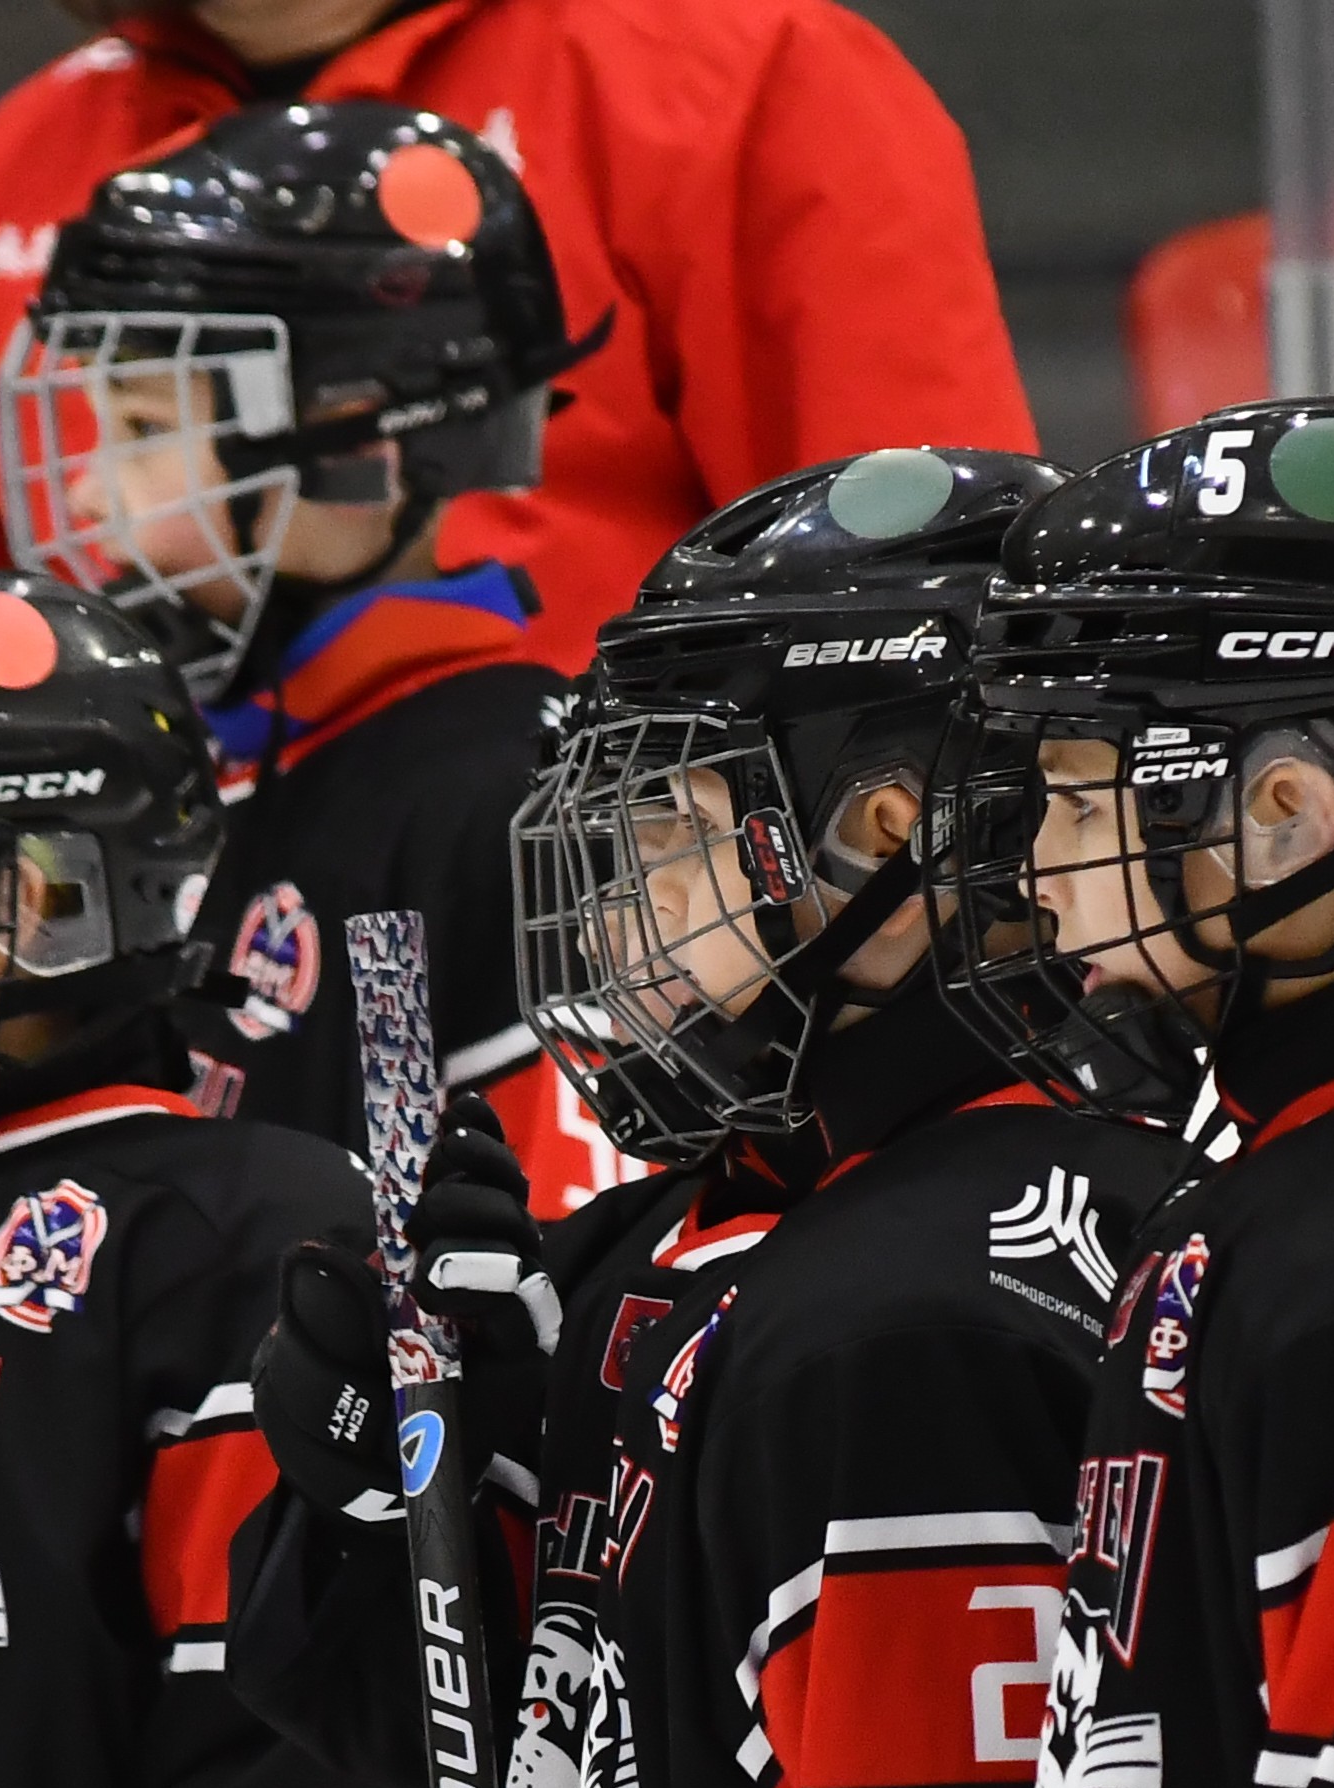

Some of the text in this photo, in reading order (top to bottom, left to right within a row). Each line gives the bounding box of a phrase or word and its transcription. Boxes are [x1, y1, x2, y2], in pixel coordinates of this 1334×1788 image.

[1197, 430, 1254, 516] 5
[1131, 758, 1229, 784] CCM
[327, 1383, 356, 1440] NEXT
[344, 1397, 370, 1443] CCM
